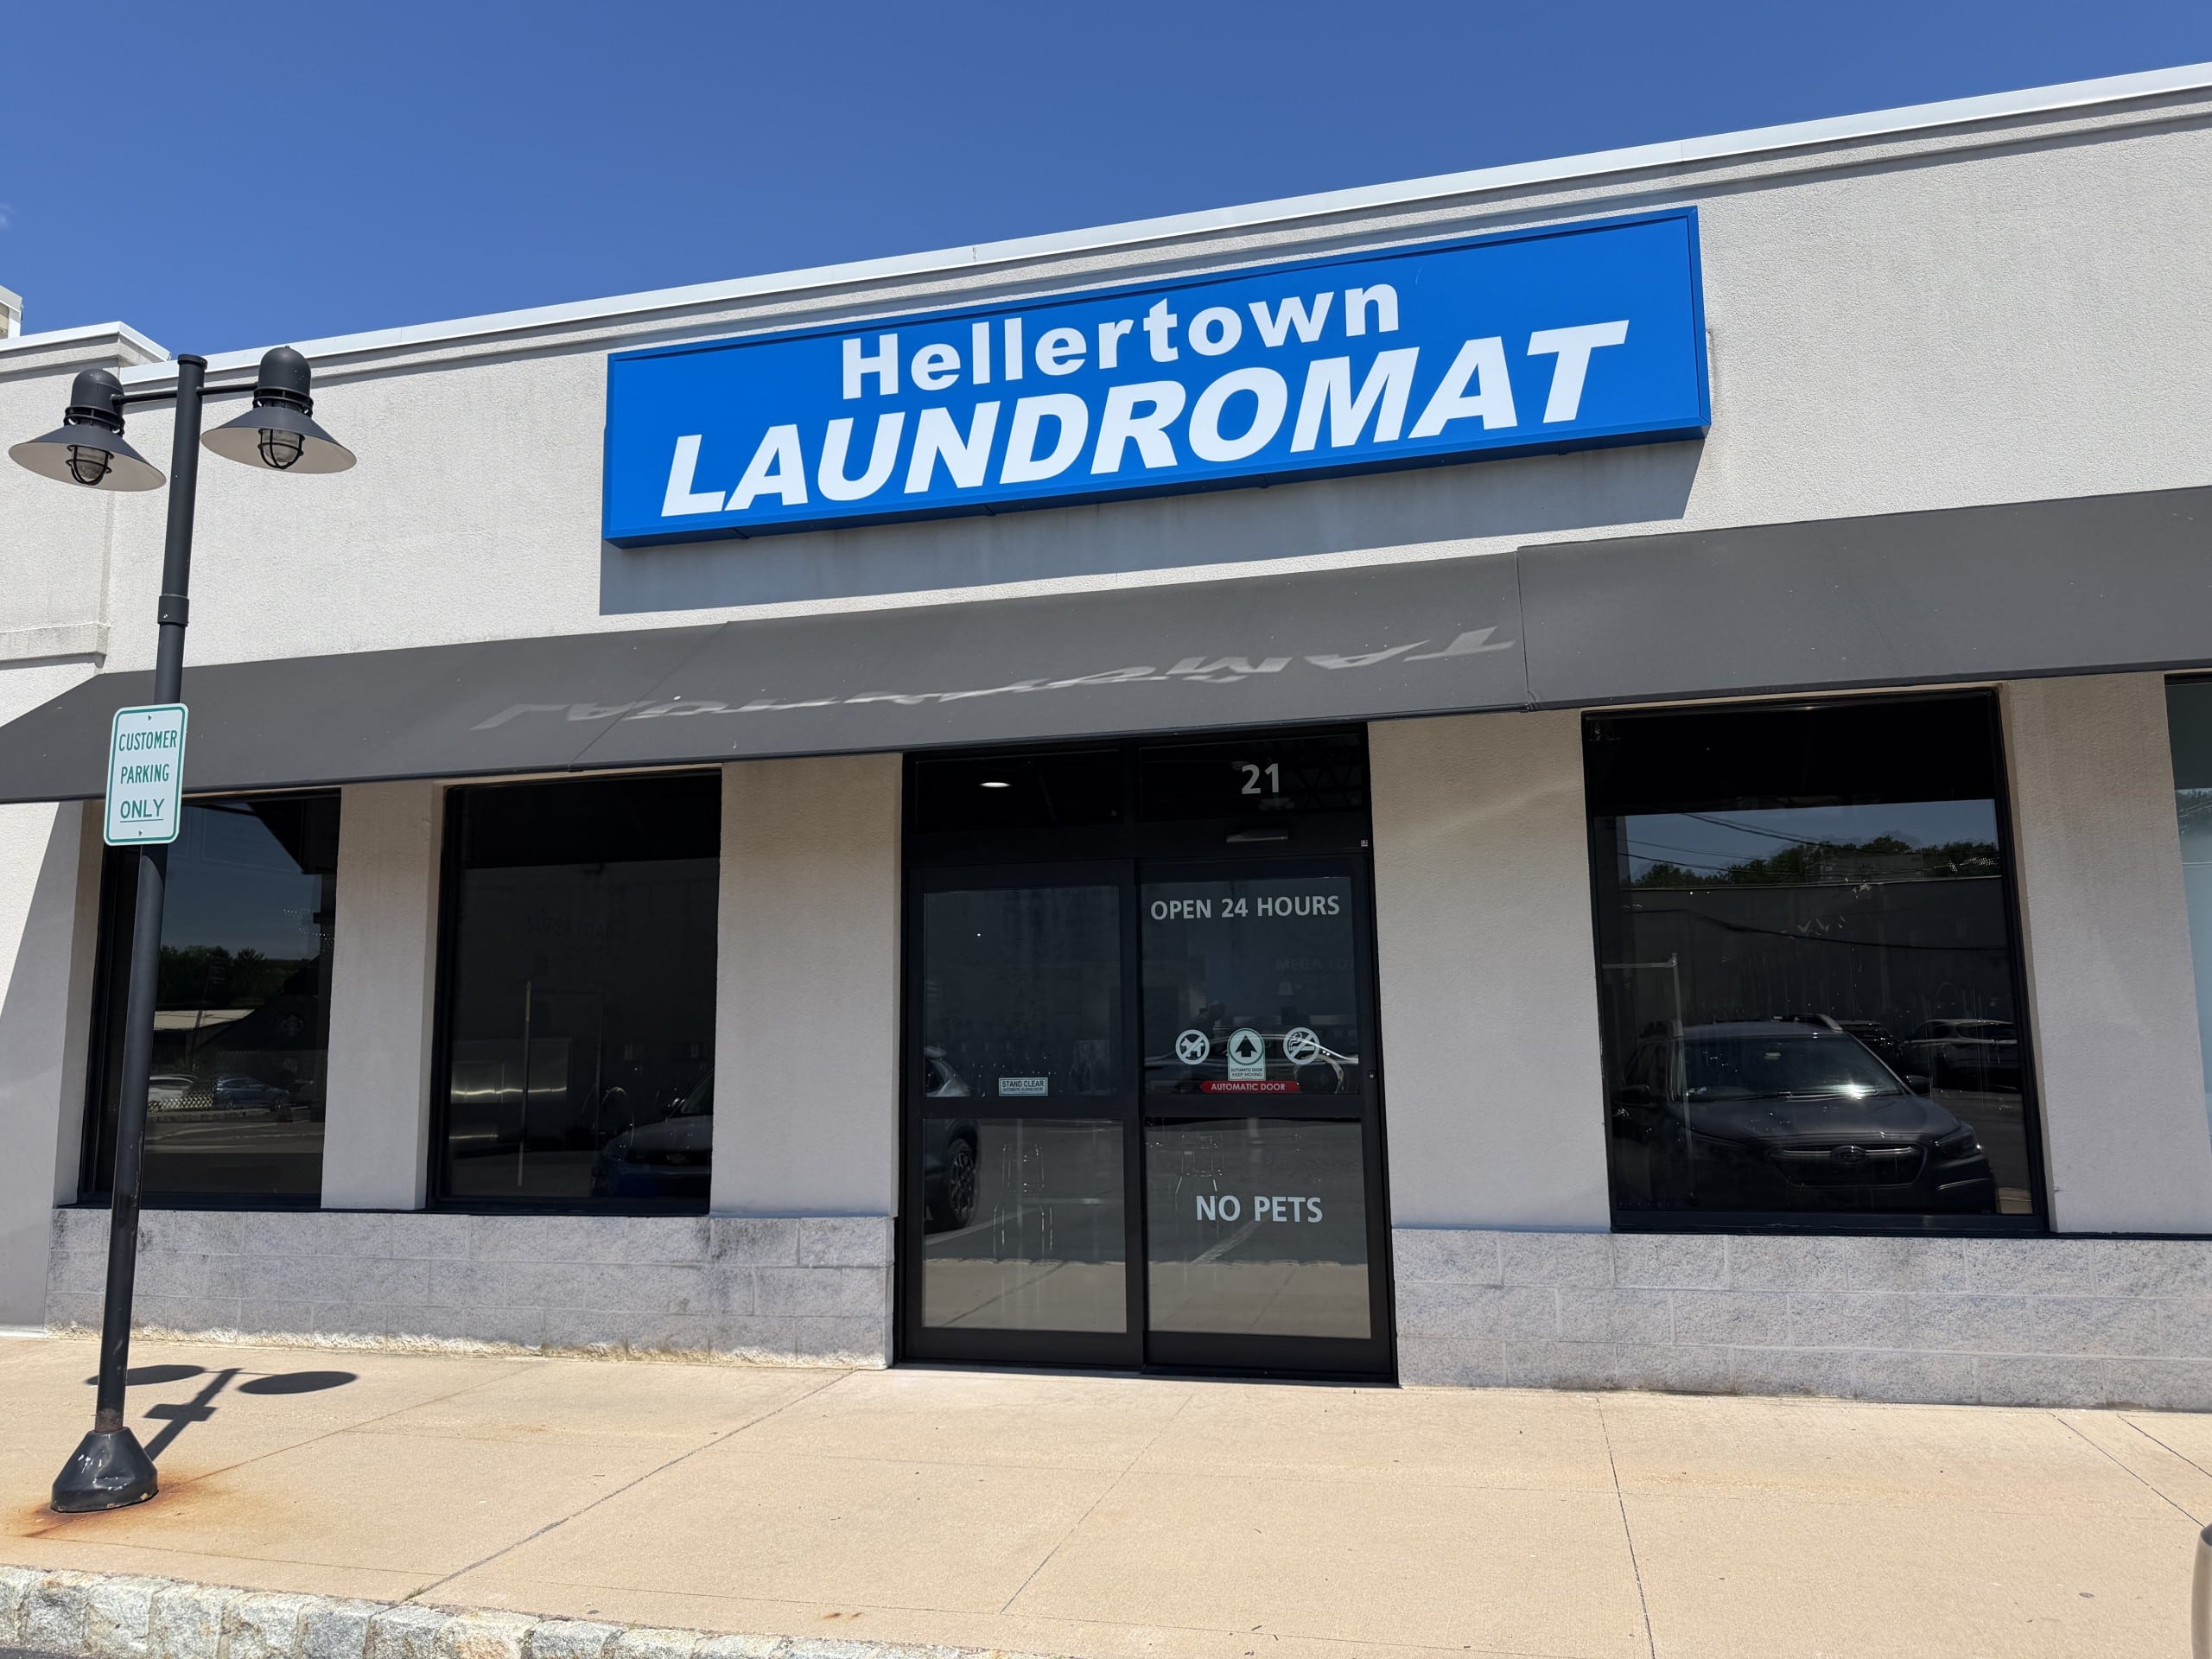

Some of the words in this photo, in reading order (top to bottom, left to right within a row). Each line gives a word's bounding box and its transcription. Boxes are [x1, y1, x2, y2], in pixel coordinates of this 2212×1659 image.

[842, 306, 1399, 400] Hellertown
[661, 320, 1630, 517] LAUNDROMAT
[118, 729, 178, 752] CUSTOMER
[120, 763, 170, 785] PARKING
[1242, 763, 1280, 795] 21
[120, 798, 165, 819] ONLY
[1150, 899, 1211, 920] OPEN
[1221, 898, 1249, 918] 24
[1257, 895, 1340, 917] HOURS
[1211, 1083, 1259, 1091] AUTOMATIC
[1260, 1083, 1286, 1091] DOOR
[1196, 1195, 1241, 1222] NO
[1254, 1196, 1323, 1224] PETS
